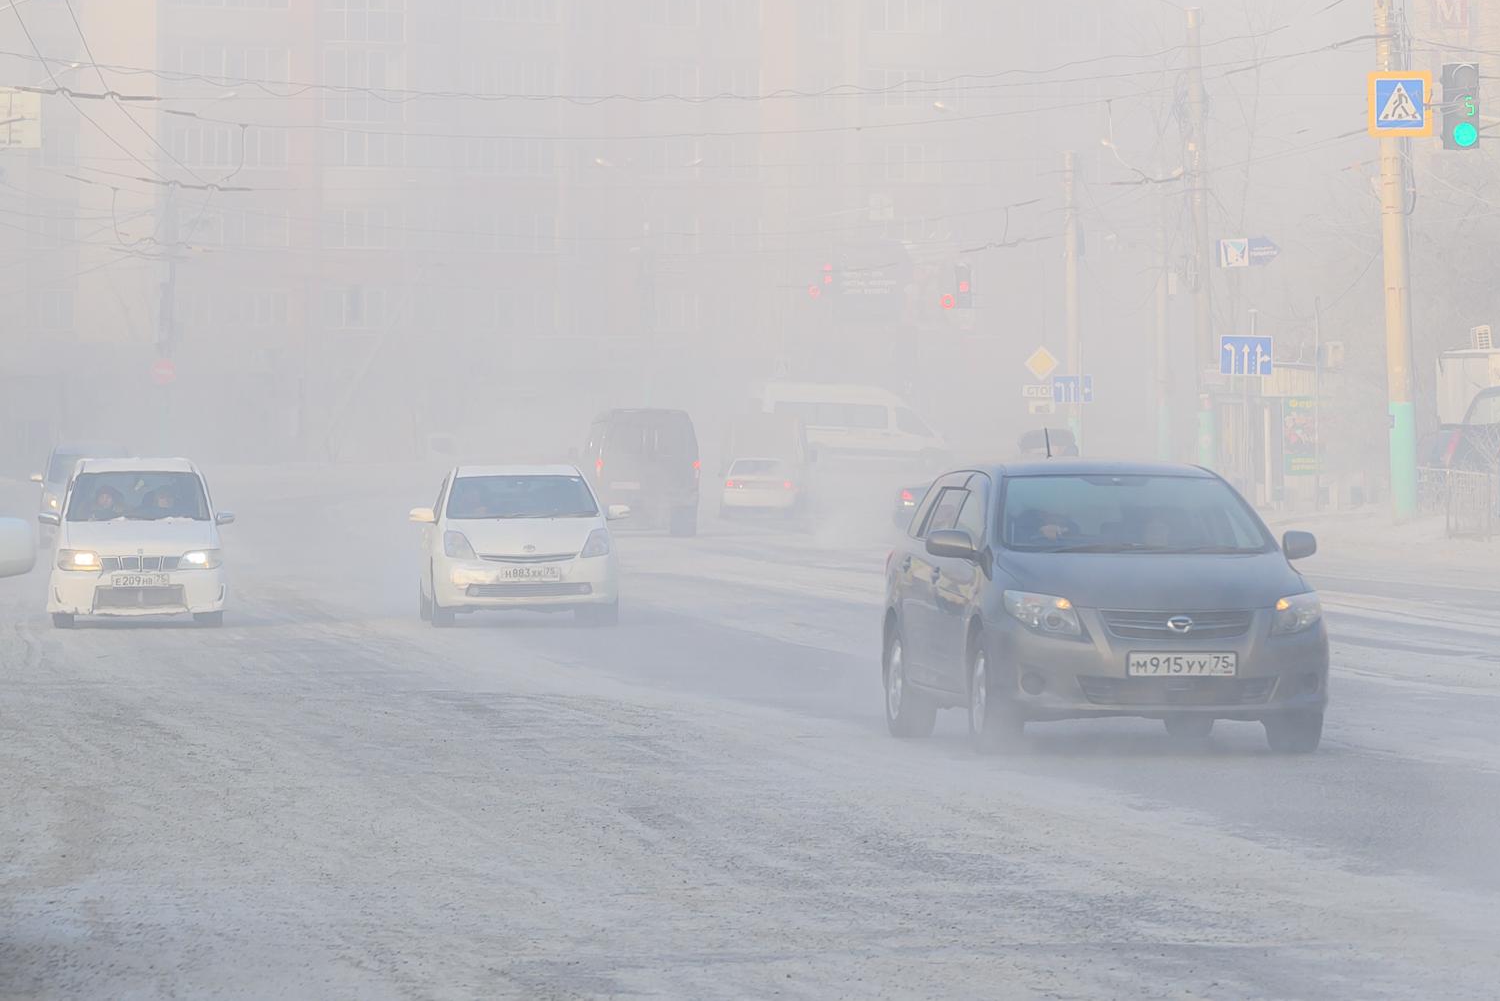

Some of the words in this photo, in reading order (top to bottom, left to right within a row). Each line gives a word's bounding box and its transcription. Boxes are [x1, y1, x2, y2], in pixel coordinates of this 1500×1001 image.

[1464, 95, 1476, 117] 5
[1135, 655, 1210, 674] М915УУ
[1212, 655, 1231, 670] 75
